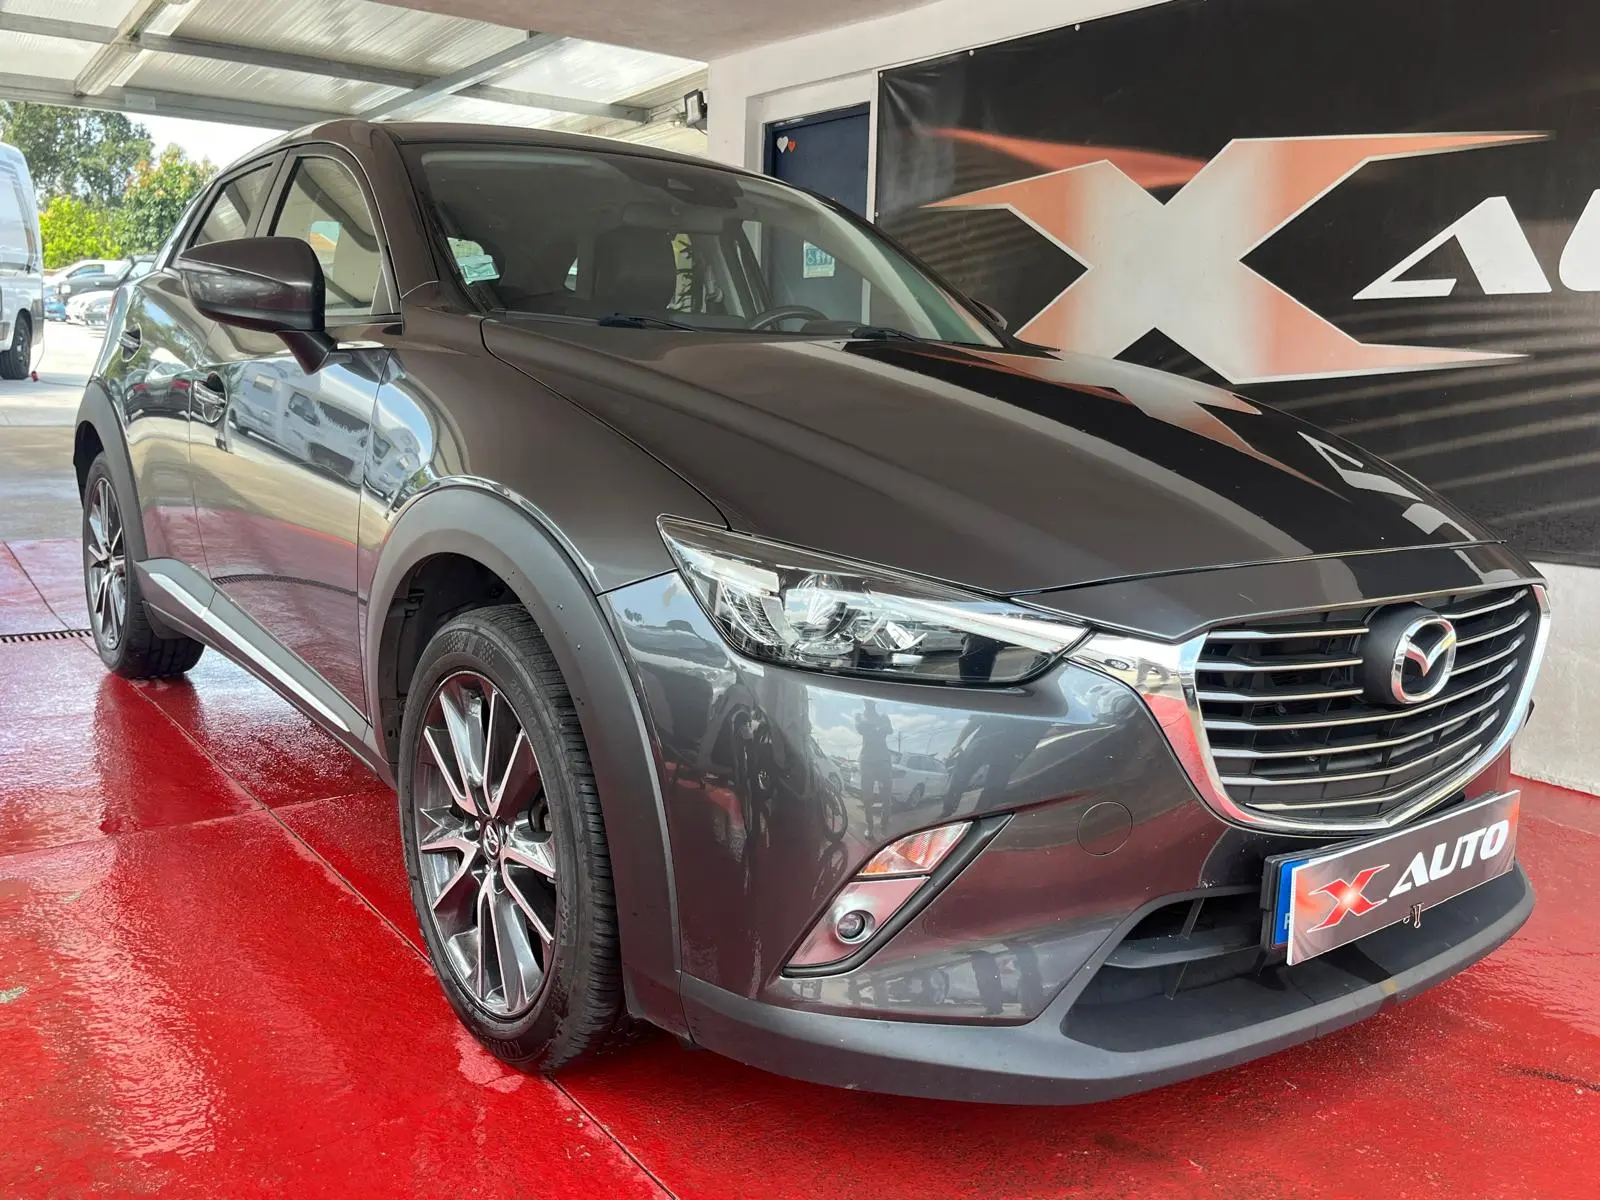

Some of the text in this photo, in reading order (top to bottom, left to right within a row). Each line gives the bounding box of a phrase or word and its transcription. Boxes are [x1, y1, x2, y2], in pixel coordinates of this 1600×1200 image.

[920, 131, 1552, 384] X
[1306, 819, 1509, 933] X AUTO
